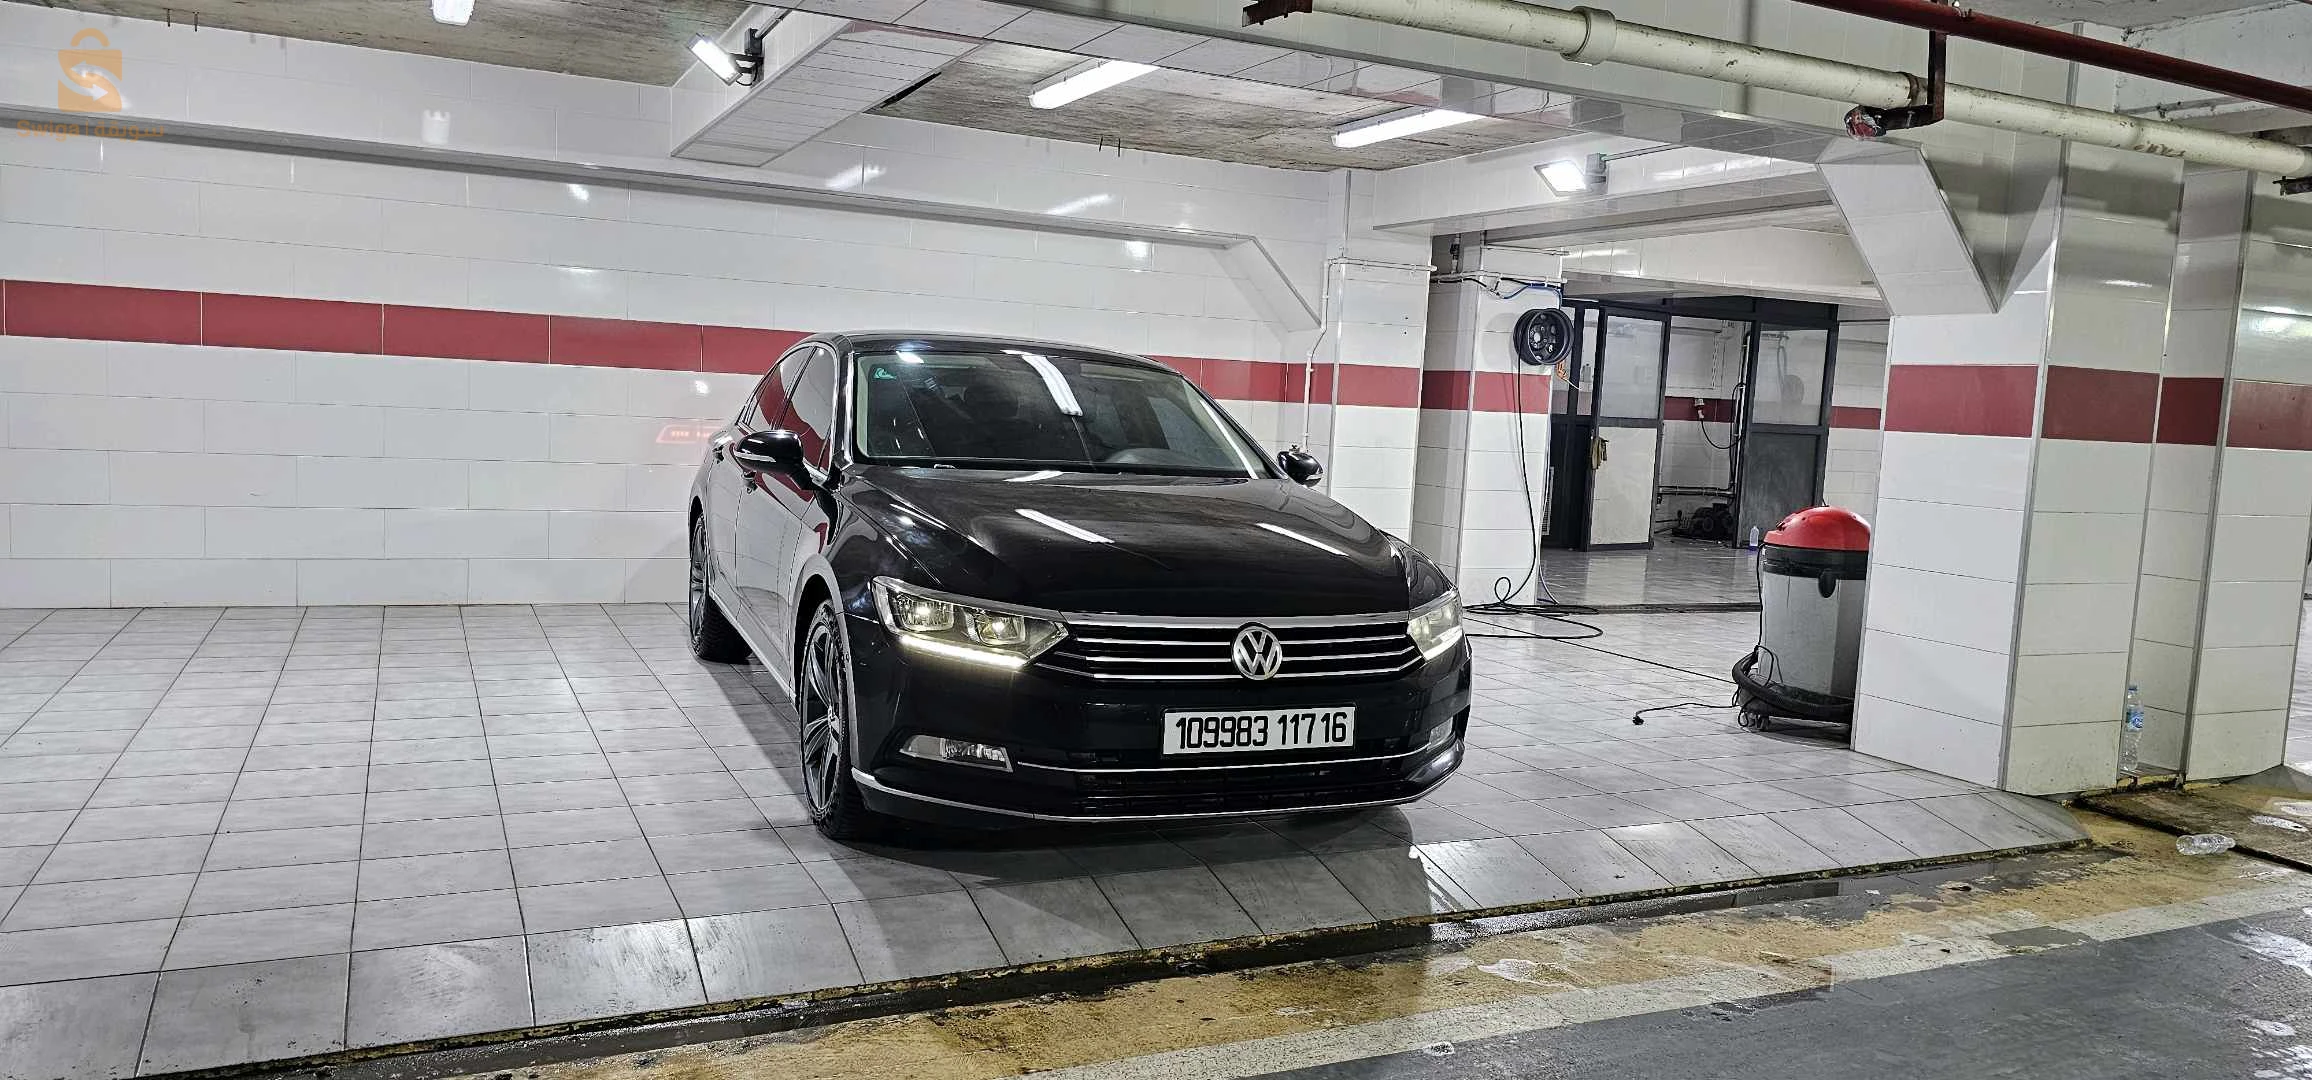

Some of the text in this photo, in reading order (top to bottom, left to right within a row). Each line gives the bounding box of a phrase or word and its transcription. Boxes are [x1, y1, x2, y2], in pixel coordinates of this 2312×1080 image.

[1234, 627, 1282, 680] VW
[1176, 711, 1347, 749] 109983 117 16
